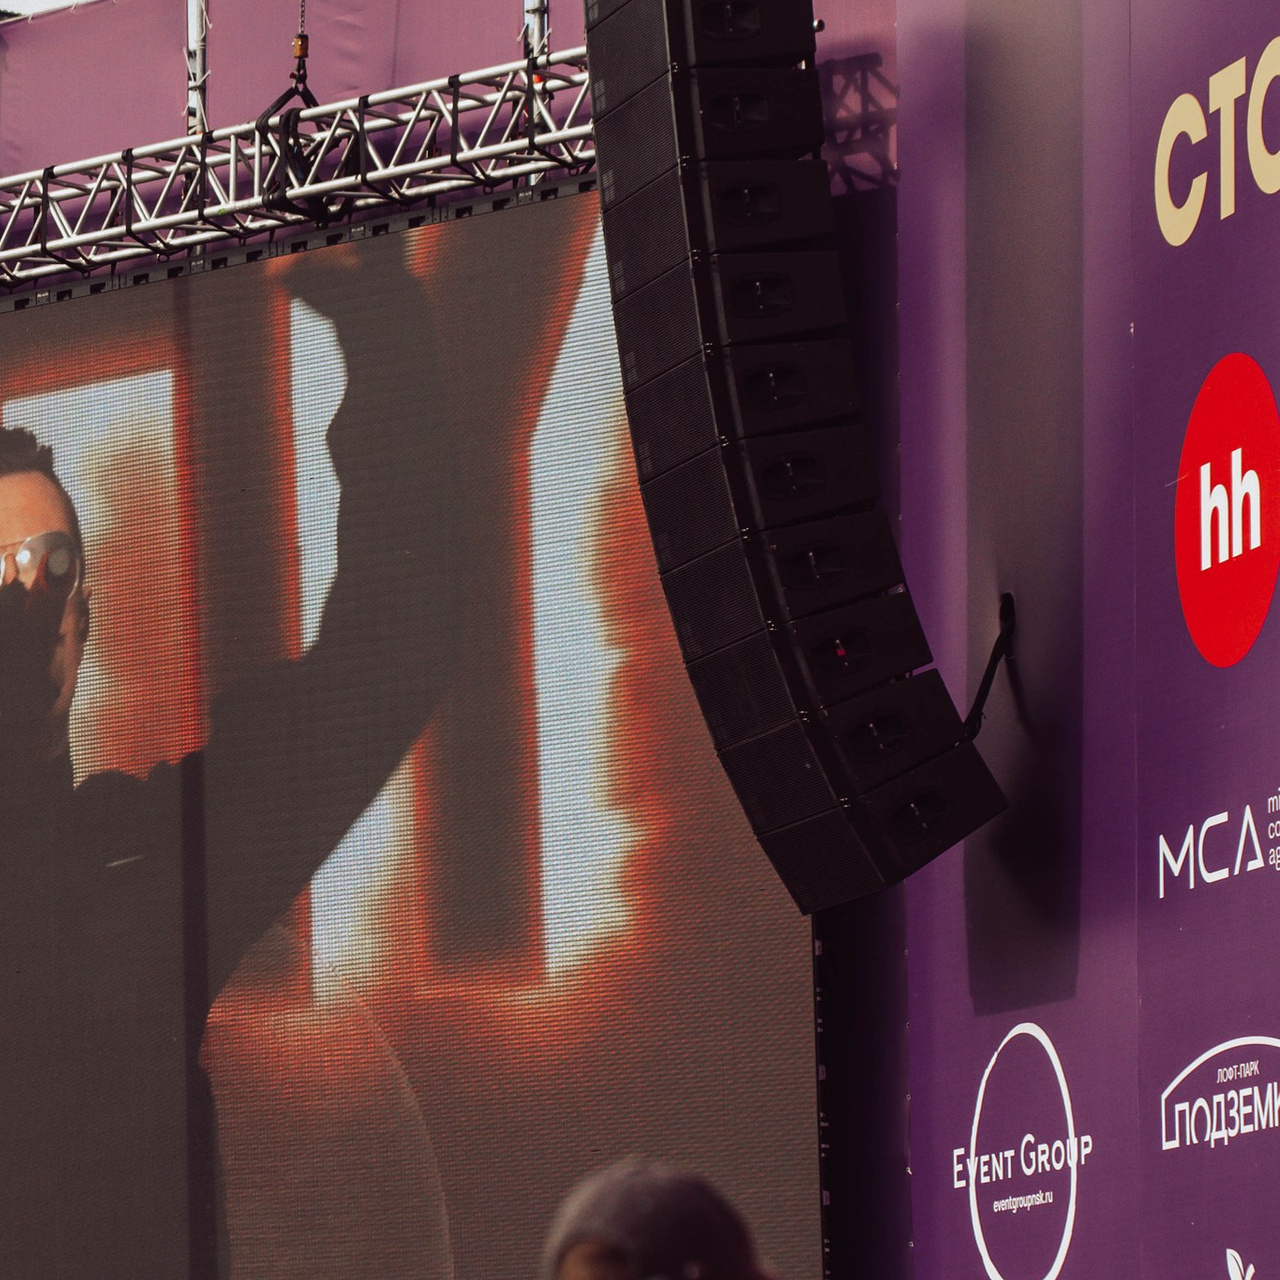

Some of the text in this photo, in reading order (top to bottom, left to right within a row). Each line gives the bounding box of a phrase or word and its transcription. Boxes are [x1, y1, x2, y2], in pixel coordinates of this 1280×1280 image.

[1154, 35, 1280, 247] СТО
[1200, 447, 1261, 572] hh
[1216, 1059, 1260, 1084] ЛОФТ-ПАРК
